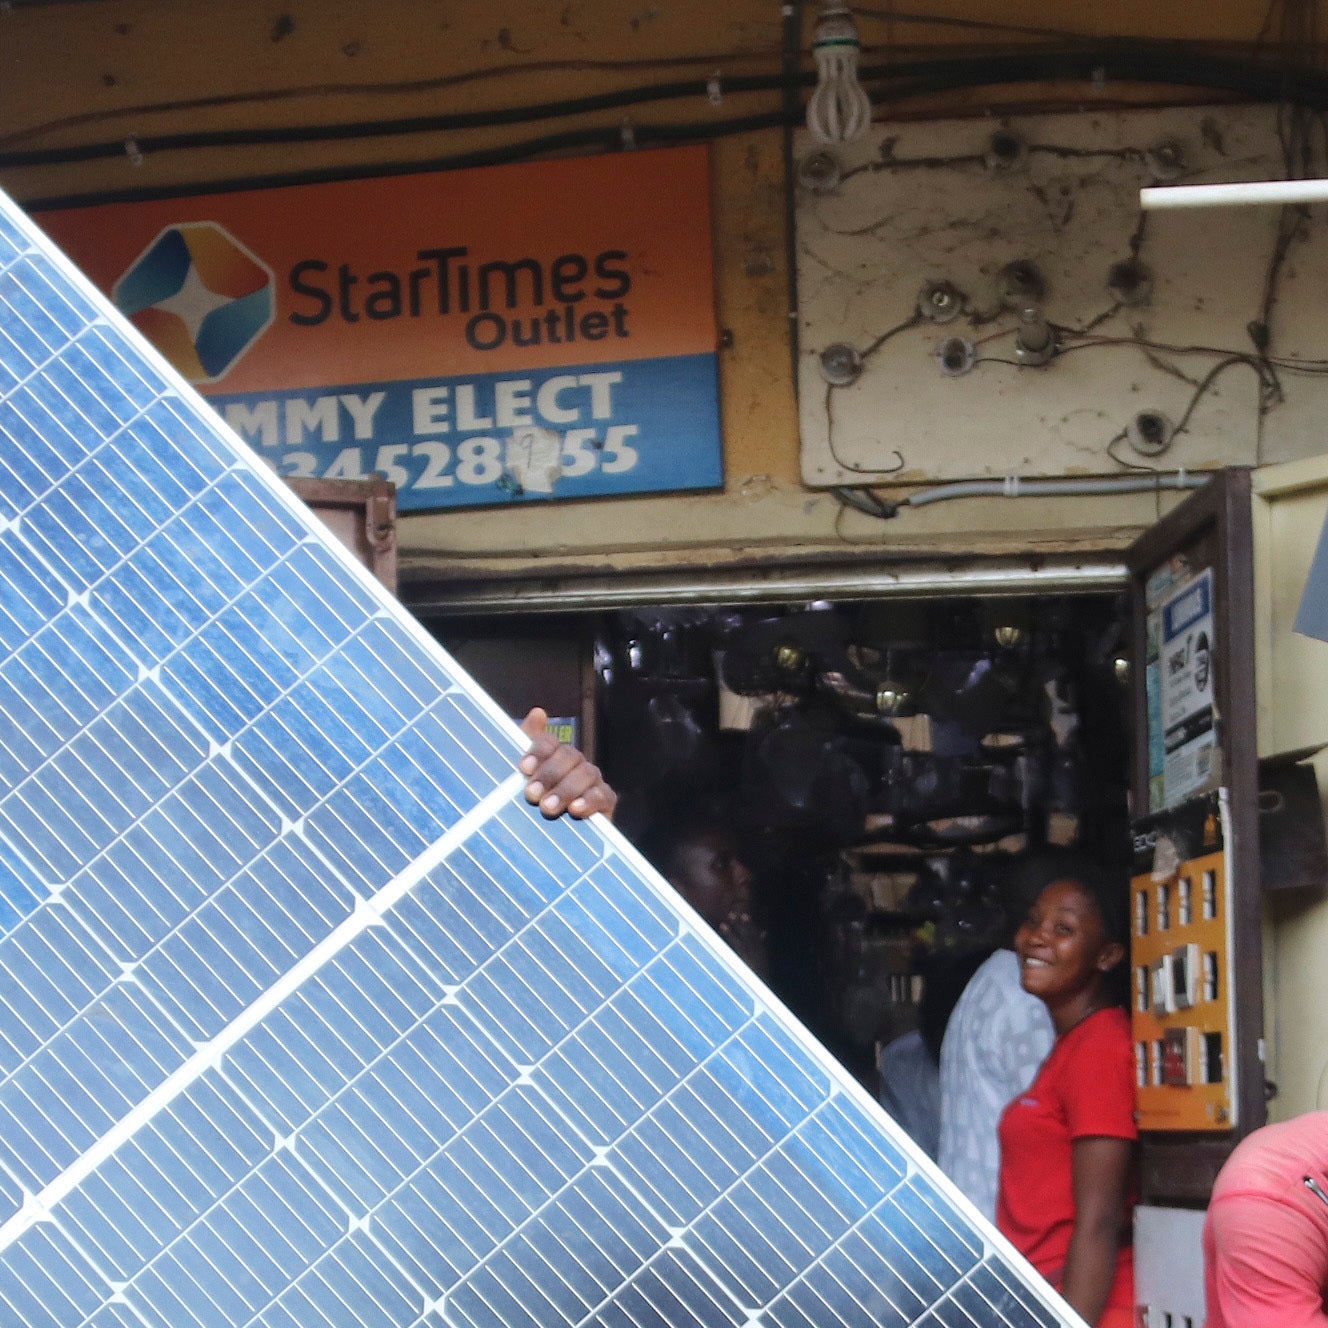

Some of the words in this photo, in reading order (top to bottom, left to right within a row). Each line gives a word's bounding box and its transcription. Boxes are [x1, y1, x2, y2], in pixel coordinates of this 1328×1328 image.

[289, 246, 632, 327] StarTimes
[465, 302, 631, 351] Outlet
[211, 391, 386, 447] MMY
[412, 371, 623, 435] ELECT
